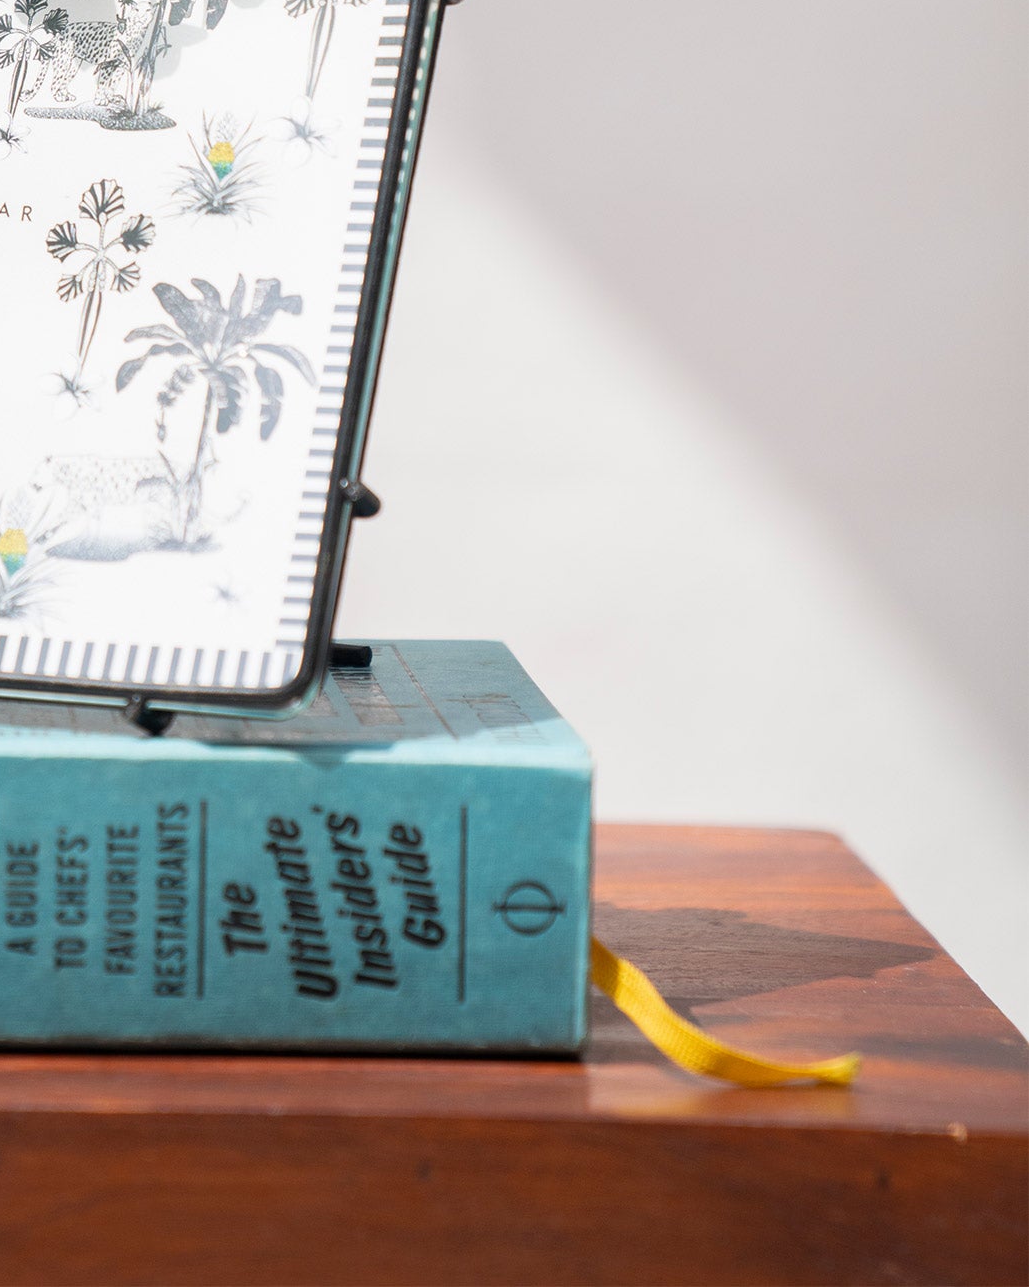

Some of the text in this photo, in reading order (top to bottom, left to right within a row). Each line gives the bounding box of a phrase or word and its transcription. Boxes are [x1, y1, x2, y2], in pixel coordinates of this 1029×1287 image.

[4, 840, 40, 957] A GUIDE
[54, 936, 87, 972] TO
[104, 823, 141, 977] FAVOURITE
[154, 801, 190, 998] RESTAURANTS
[220, 881, 270, 958] The
[264, 815, 340, 1002] Ultimate
[311, 805, 400, 991] Insiders'
[384, 820, 446, 950] Guide
